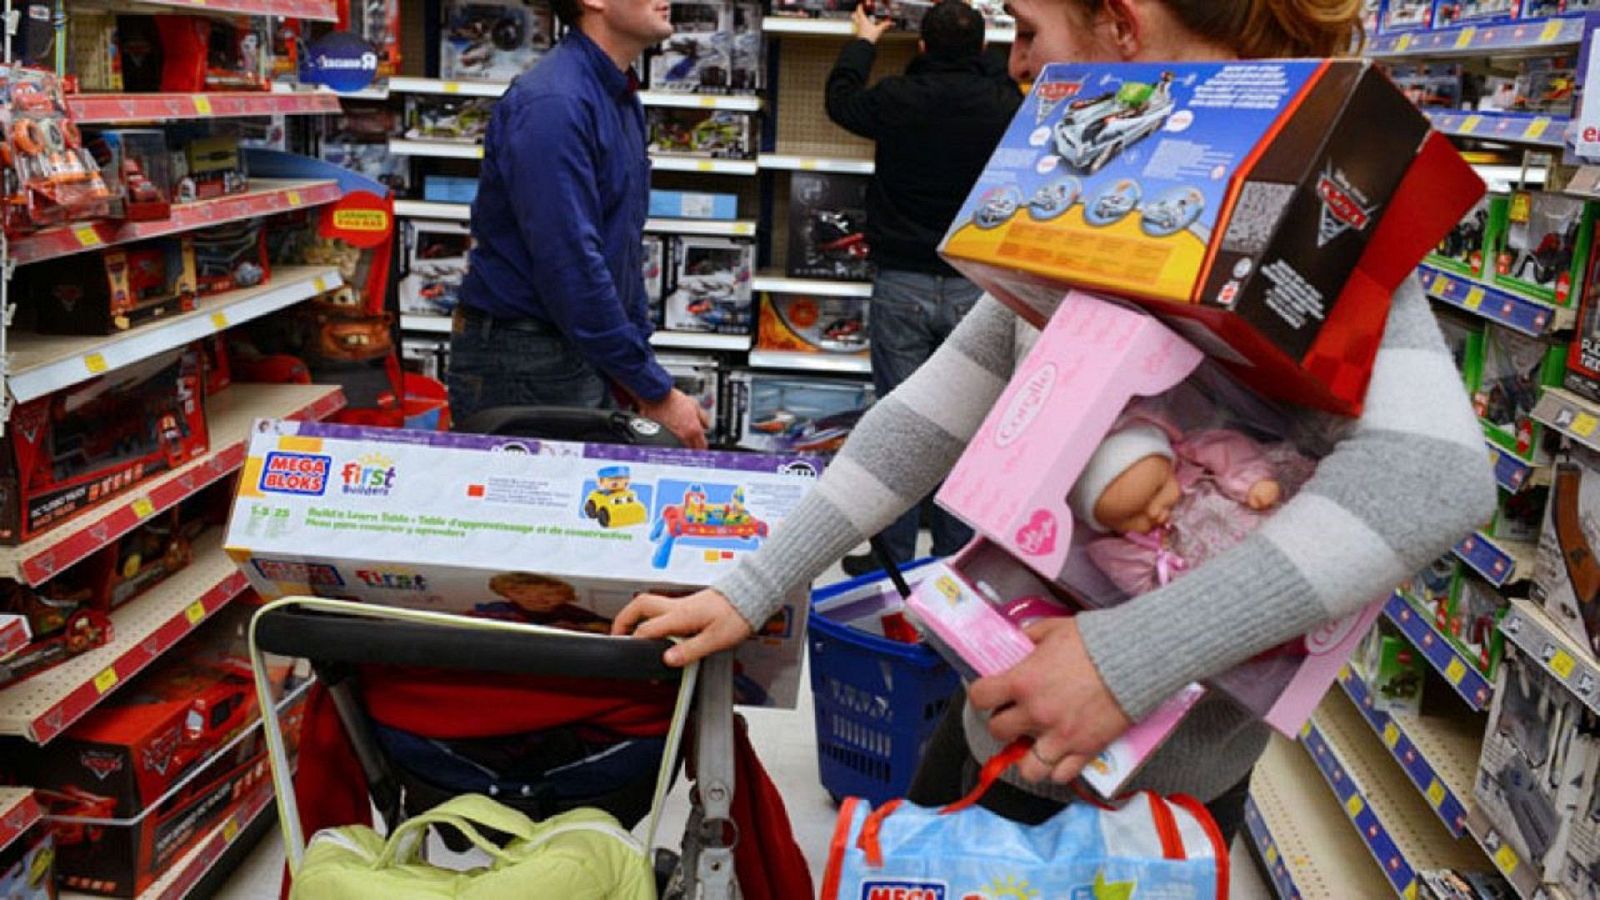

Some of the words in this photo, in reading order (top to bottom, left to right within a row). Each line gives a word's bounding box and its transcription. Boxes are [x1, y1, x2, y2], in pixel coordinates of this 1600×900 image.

[269, 456, 326, 474] MEGA
[265, 472, 323, 491] BLOKS
[340, 462, 397, 489] first
